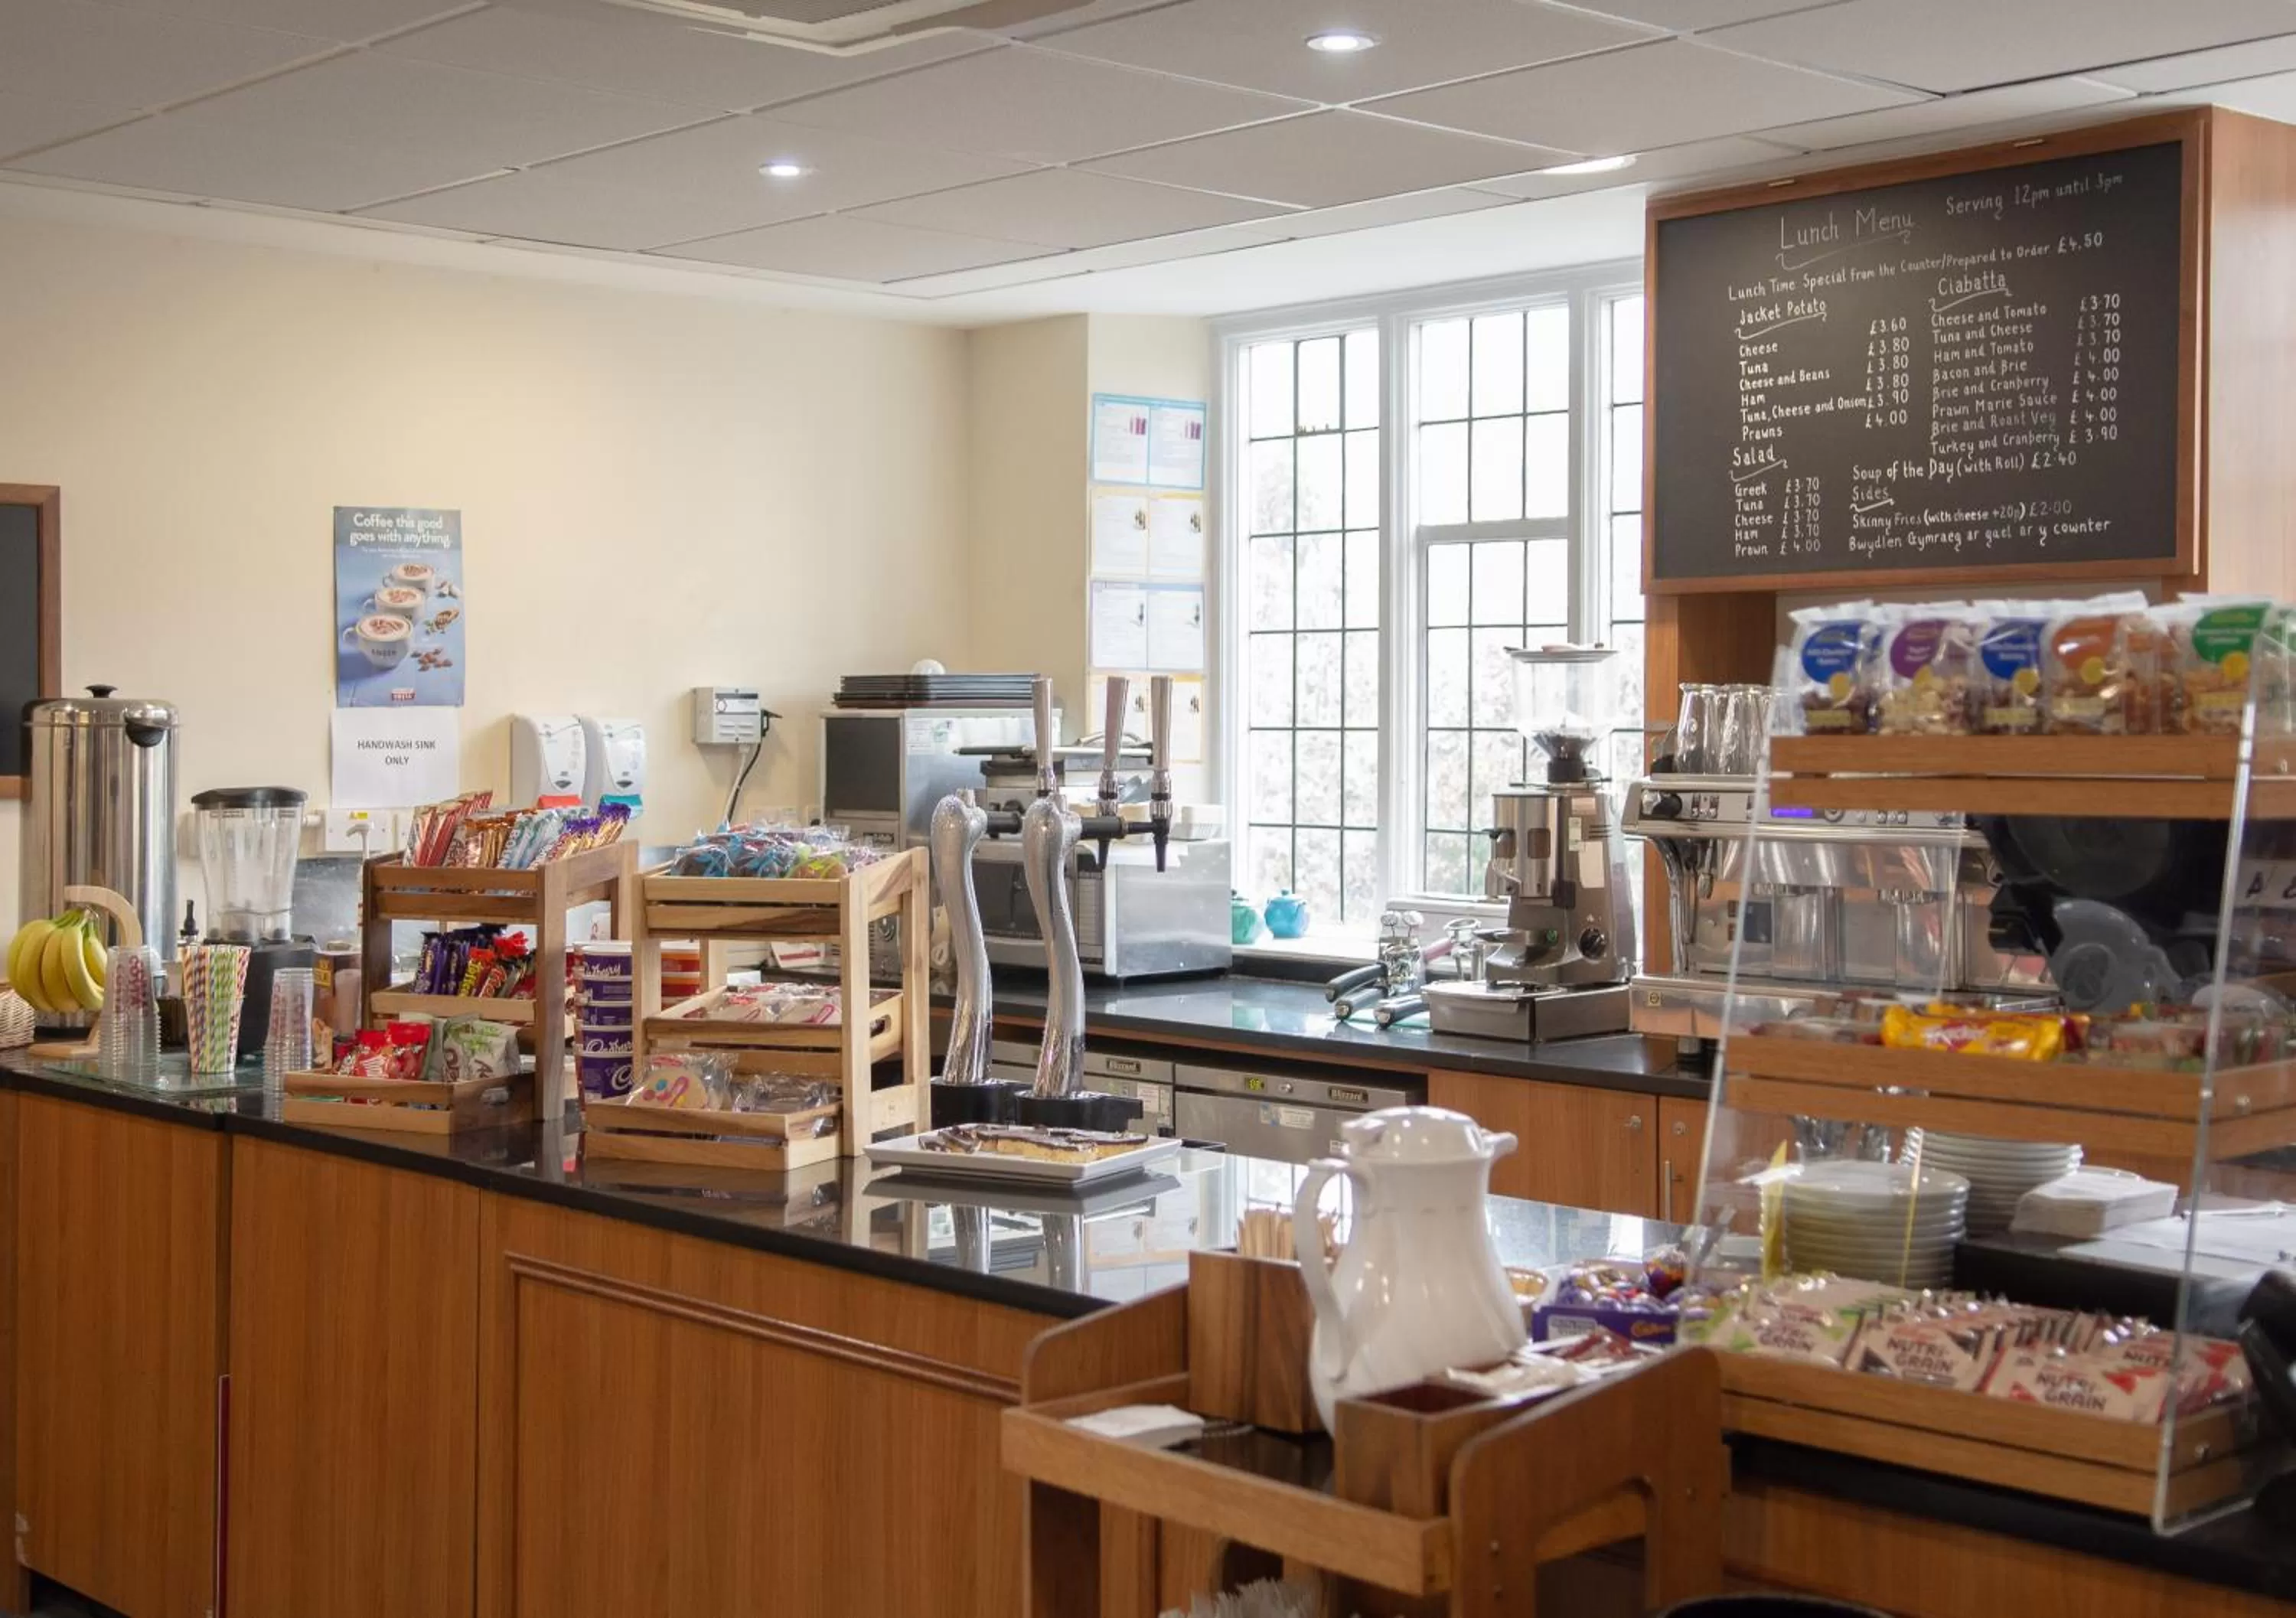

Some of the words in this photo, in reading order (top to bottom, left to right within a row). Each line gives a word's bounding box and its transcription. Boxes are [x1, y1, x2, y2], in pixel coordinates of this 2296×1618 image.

[1947, 195, 2003, 220] Serving
[2014, 184, 2049, 208] 12pm
[2056, 177, 2089, 197] until
[1781, 211, 1838, 249] Lunch
[1855, 208, 1913, 237] Menu
[1728, 282, 1766, 301] Lunch
[1769, 278, 1795, 292] Time
[1803, 269, 1846, 293] Special
[1880, 263, 1896, 276] the
[2001, 247, 2011, 259] to
[2017, 244, 2050, 258] Order
[2057, 231, 2102, 253] £4.50
[1740, 304, 1781, 325] Jacket
[1787, 298, 1826, 316] Potato
[1931, 312, 1974, 327] Cheese
[1978, 308, 1999, 322] and
[2004, 302, 2047, 319] Tomato
[1740, 342, 1778, 357] Cheese
[1870, 317, 1906, 335] £3.60
[1932, 329, 1960, 344] Tuna
[1965, 326, 1985, 339] and
[1991, 323, 2033, 337] Cheese
[1739, 361, 1769, 376] Tuna
[1867, 336, 1909, 356] £3.80
[1934, 349, 1959, 364] Ham
[1965, 344, 1985, 358] and
[1990, 338, 2033, 354] Tomato
[1740, 376, 1774, 390] Cheese
[1777, 370, 1795, 385] and
[1799, 369, 1830, 382] Beans
[1867, 354, 1909, 374] £3.80
[1933, 368, 1968, 383] Bacon
[1975, 362, 1995, 377] and
[2001, 360, 2027, 375] Brie
[1740, 393, 1766, 406] Ham
[1866, 373, 1909, 391] £3.80
[1933, 387, 1958, 403] Brie
[1964, 382, 1984, 395] and
[1991, 377, 2049, 395] Cranberry
[1772, 403, 1811, 419] Cheese
[1815, 396, 1834, 413] and
[1932, 404, 1968, 418] Prawn
[1975, 398, 2012, 412] Marie
[2019, 394, 2057, 408] Sauce
[1743, 426, 1782, 441] Prawns
[1865, 409, 1907, 429] £4.00
[1930, 422, 1958, 440] Brie
[1963, 417, 1985, 430] and
[1733, 444, 1775, 466] Salad
[1931, 441, 1974, 459] Turkey
[1978, 435, 1998, 449] and
[2003, 431, 2060, 452] Cranberry
[1853, 465, 1882, 484] Soup
[1887, 460, 1899, 483] of
[1903, 460, 1924, 478] the
[1929, 456, 1954, 483] Day
[1735, 482, 1767, 497] Greek
[1853, 486, 1890, 501] Sides
[1736, 499, 1764, 511] Tuna
[353, 512, 393, 527] Coffee
[396, 514, 415, 528] this
[417, 514, 443, 533] good
[1735, 514, 1773, 527] Cheese
[1853, 514, 1891, 535] Skinny
[1894, 511, 1922, 526] Fries
[350, 531, 376, 546] goes
[377, 528, 402, 543] with
[1735, 529, 1758, 541] Ham
[1848, 536, 1903, 559] Bwydlen
[2039, 526, 2047, 547] y
[1735, 543, 1769, 558] Prawn
[357, 739, 413, 750] HANDWASH
[415, 739, 436, 750] SINK
[385, 755, 409, 765] ONLY
